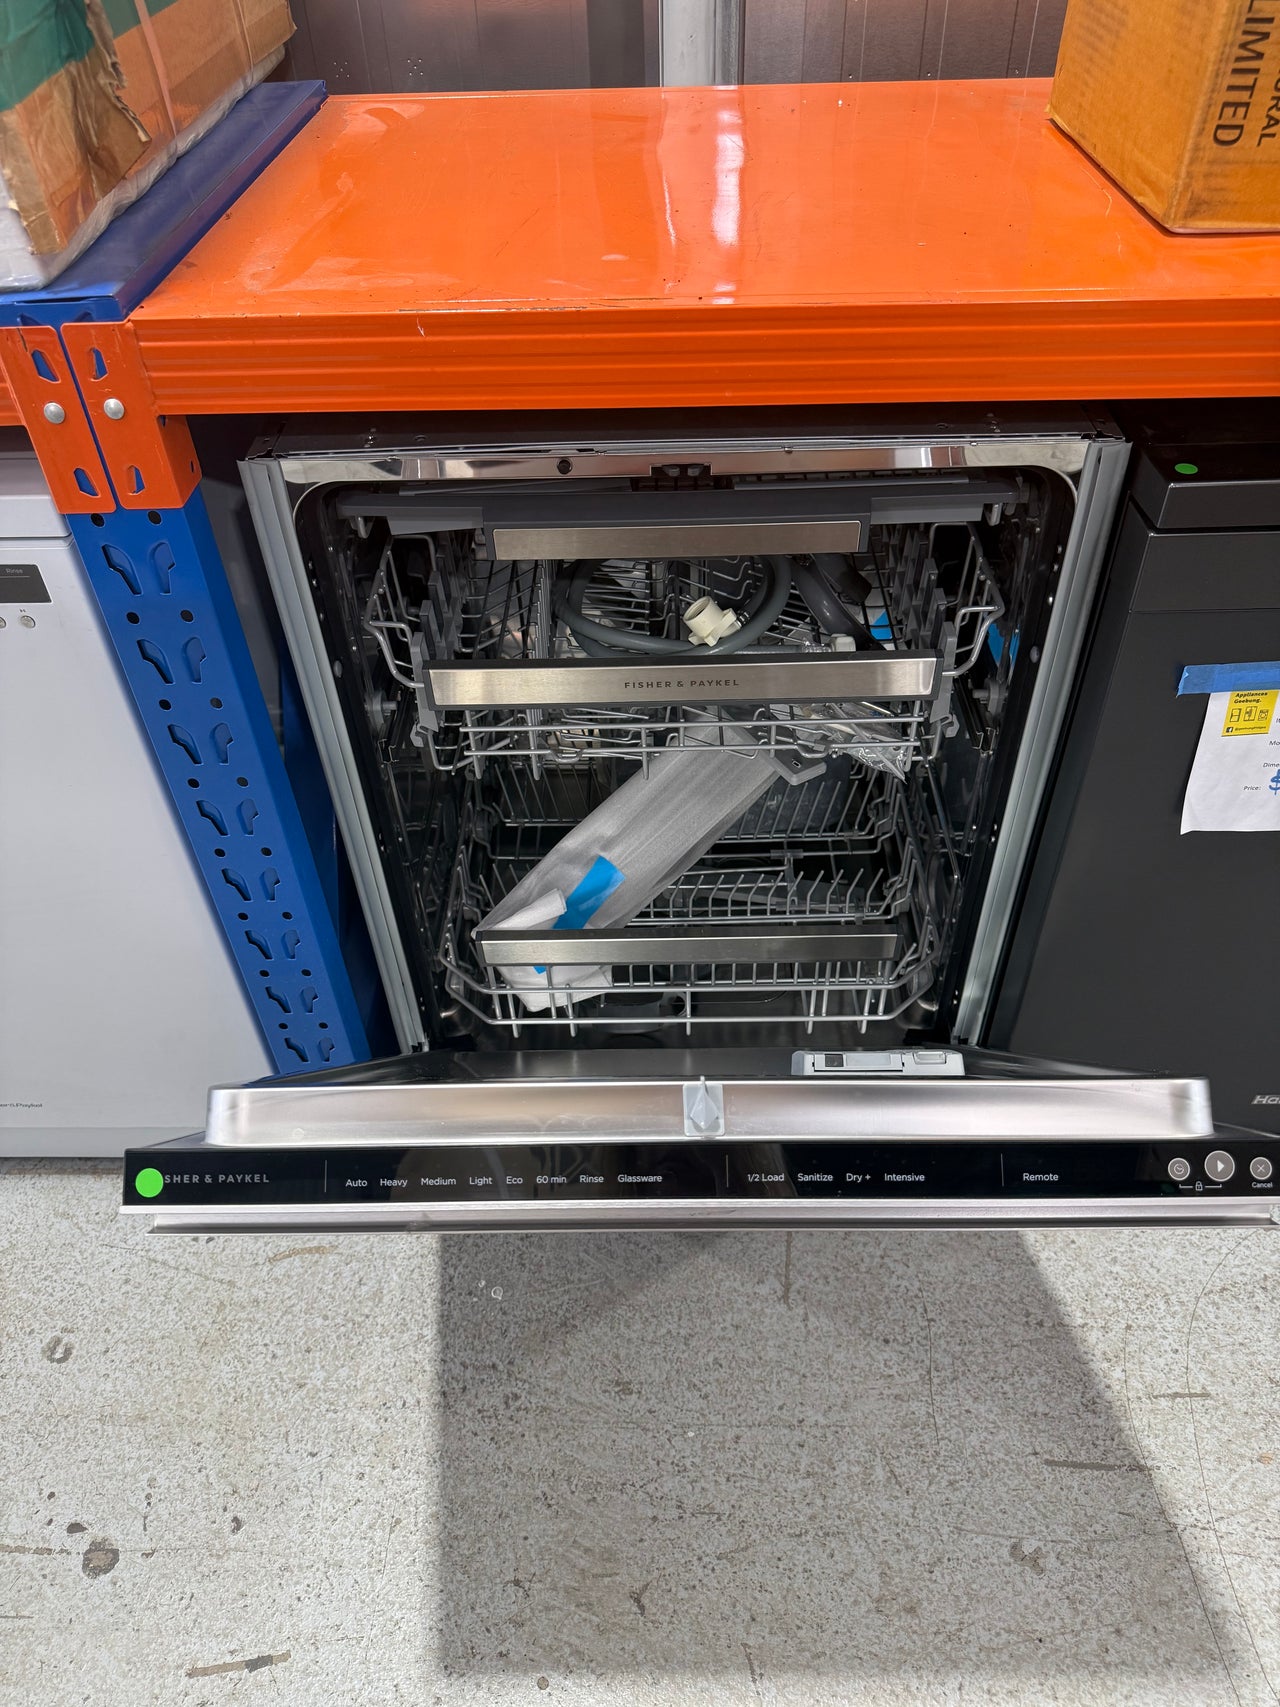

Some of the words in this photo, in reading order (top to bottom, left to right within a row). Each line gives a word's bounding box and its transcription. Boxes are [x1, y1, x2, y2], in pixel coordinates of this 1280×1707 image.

[624, 681, 672, 689] FISHER
[676, 680, 684, 688] &
[690, 679, 740, 687] PAYKEL
[204, 1173, 213, 1183] &
[218, 1172, 270, 1183] PAYKEL
[345, 1178, 368, 1187] Auto
[379, 1178, 408, 1188] Heavy
[421, 1177, 457, 1186] Medium
[469, 1176, 493, 1186] Light
[506, 1176, 523, 1184] Eco
[536, 1175, 549, 1184] 60
[550, 1176, 567, 1184] min
[579, 1174, 604, 1183] Rinse
[617, 1174, 663, 1183] Glassware
[747, 1173, 760, 1182] 1/2
[762, 1173, 785, 1182] Load
[797, 1173, 834, 1182] Sanitize
[846, 1173, 863, 1183] Dry
[884, 1173, 925, 1182] Intensive
[1023, 1172, 1059, 1182] Remote
